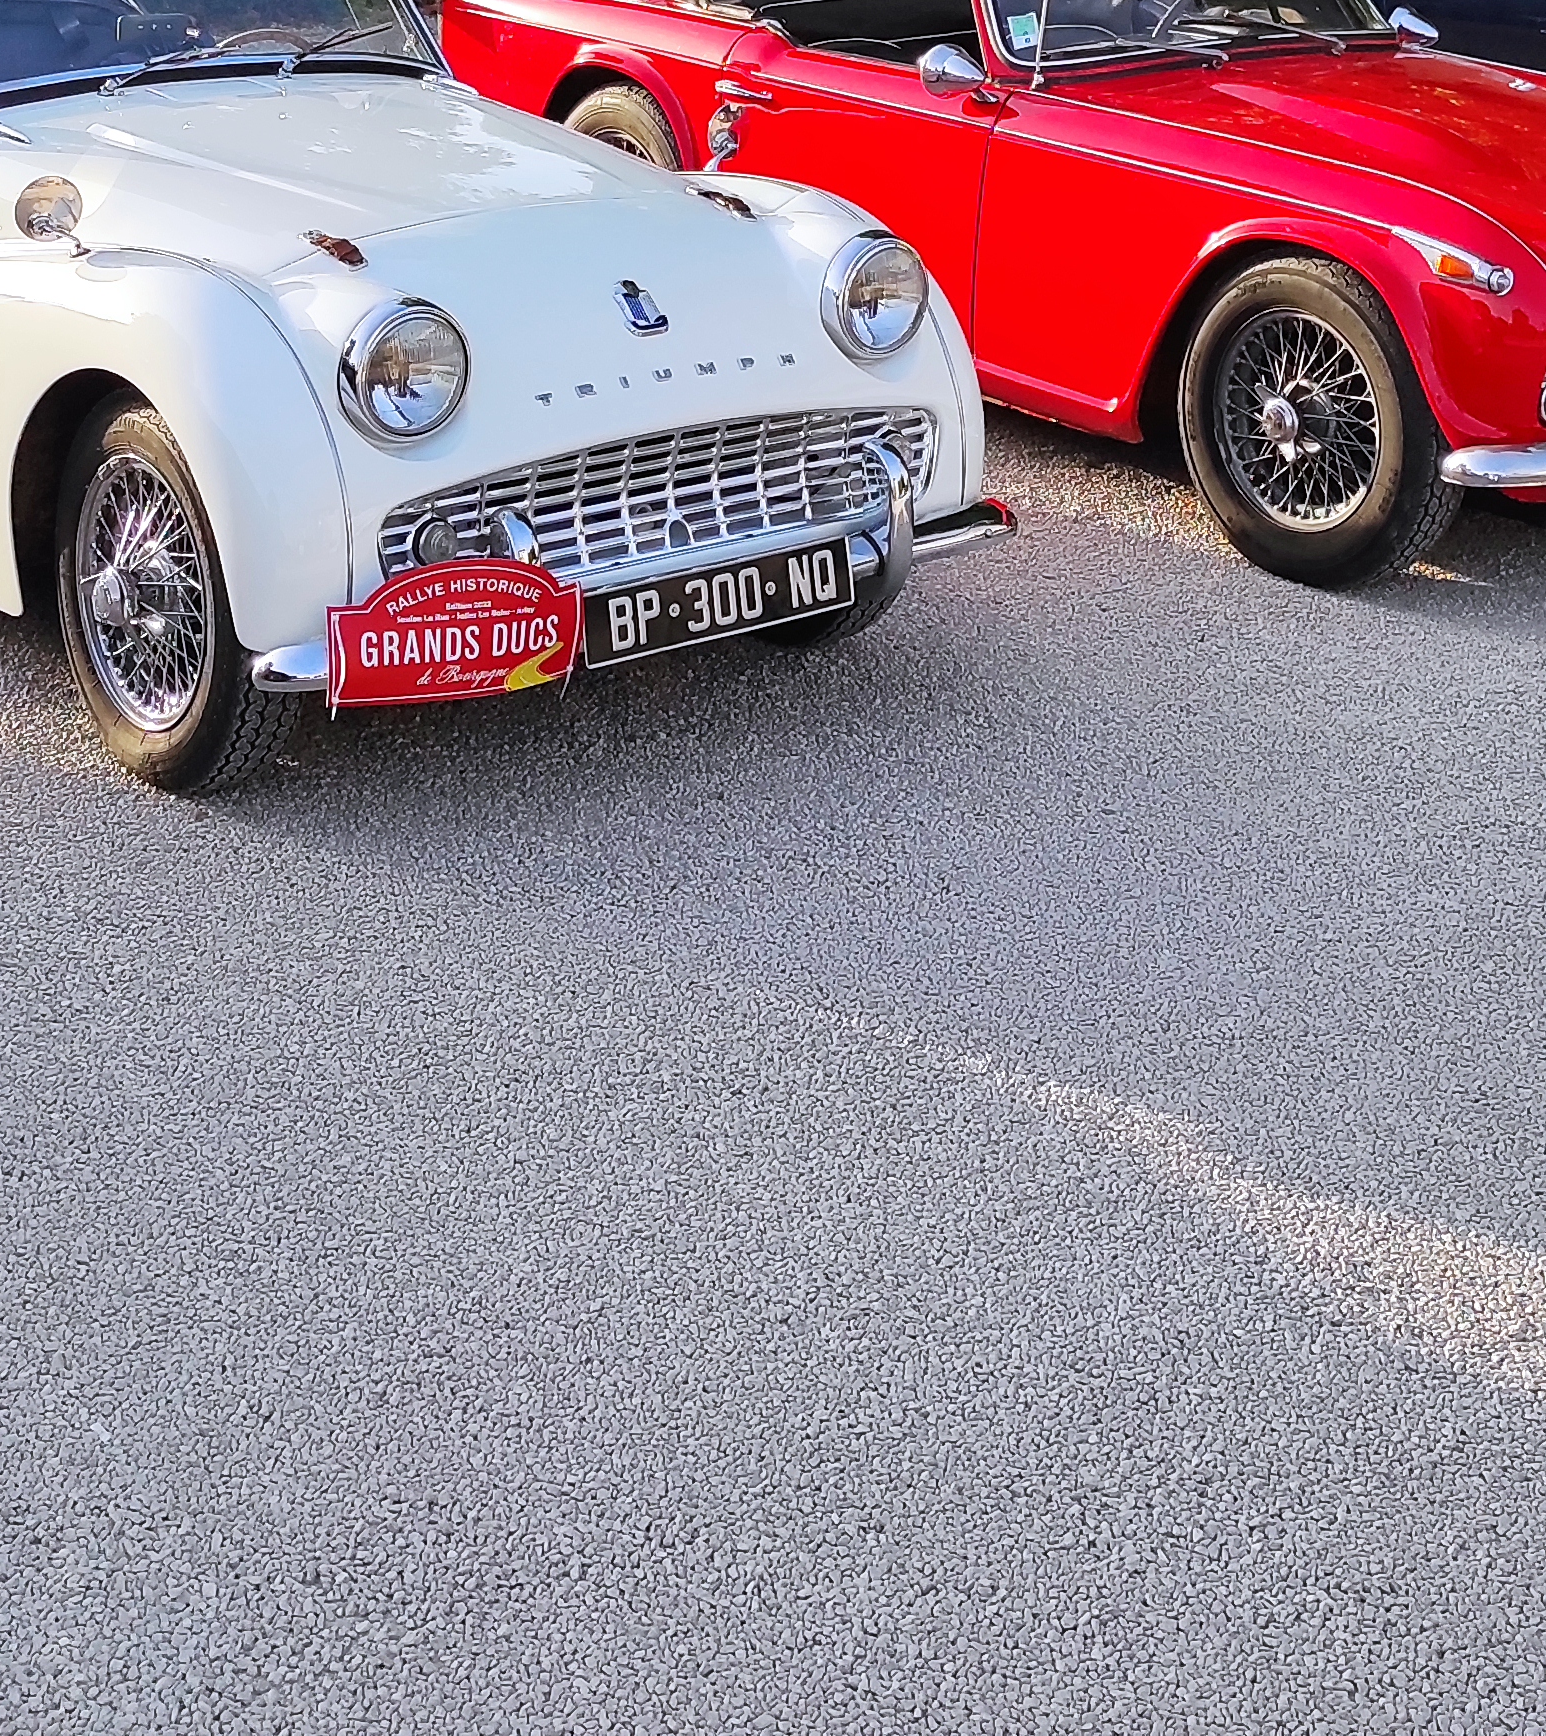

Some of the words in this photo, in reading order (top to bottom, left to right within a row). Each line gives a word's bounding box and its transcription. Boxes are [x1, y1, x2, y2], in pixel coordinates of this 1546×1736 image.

[534, 352, 797, 406] TRIUMPH
[385, 582, 446, 617] RALLYE
[450, 578, 544, 603] HISTORIQUE
[360, 625, 480, 668] GRANDS
[492, 615, 559, 657] DUCS
[416, 667, 433, 686] de
